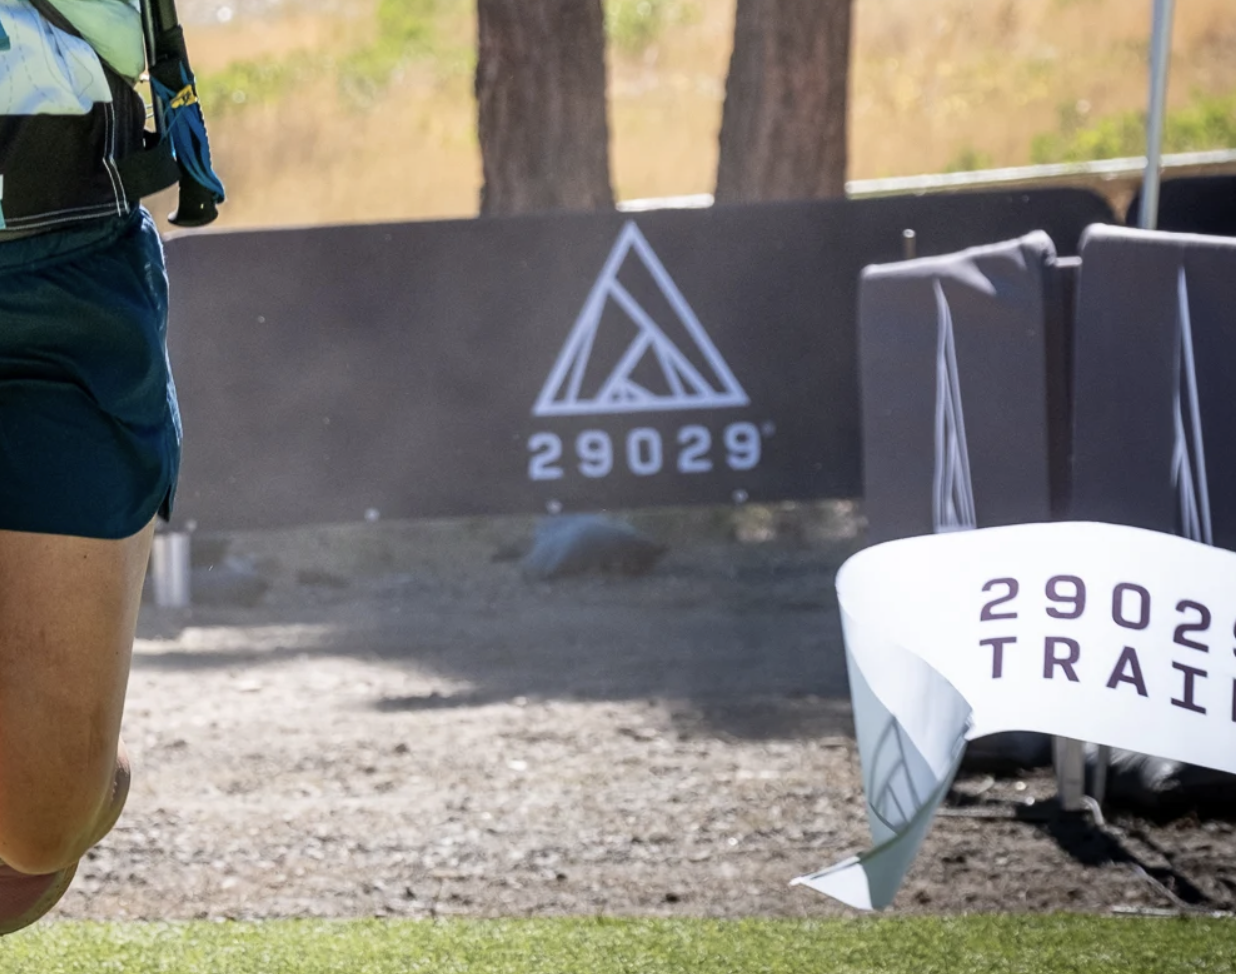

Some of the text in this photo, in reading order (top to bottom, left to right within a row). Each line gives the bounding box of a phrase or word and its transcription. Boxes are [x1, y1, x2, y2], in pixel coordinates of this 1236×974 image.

[527, 421, 762, 480] 29029
[979, 574, 1236, 658] 2902
[979, 636, 1236, 723] TRAI
